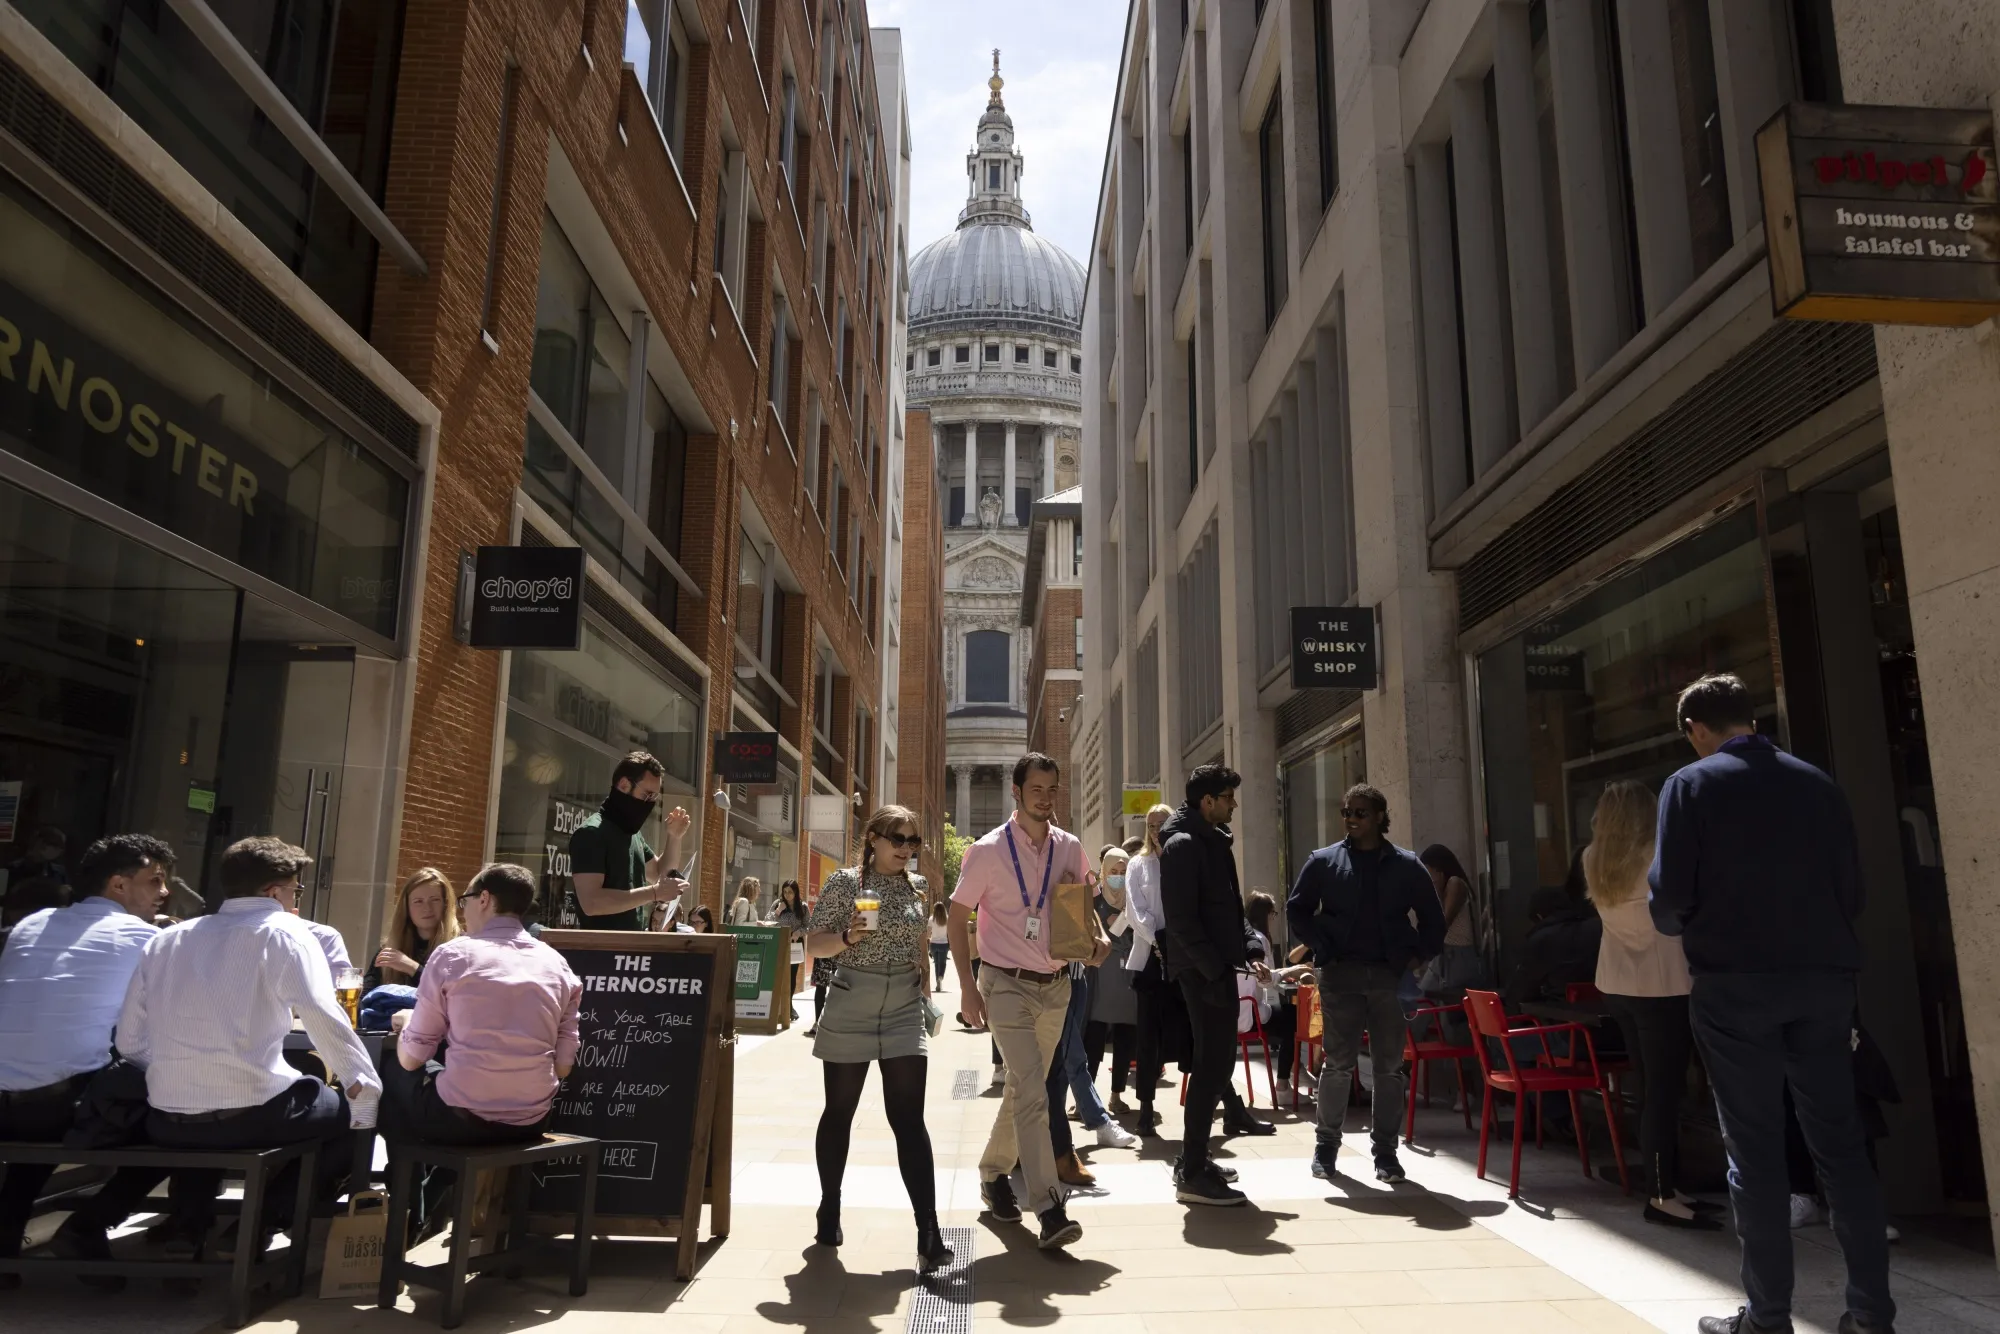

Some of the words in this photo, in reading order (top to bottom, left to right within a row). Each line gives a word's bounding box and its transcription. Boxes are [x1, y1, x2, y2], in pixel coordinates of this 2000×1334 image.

[1836, 208, 1949, 230] houmous
[1954, 213, 1974, 230] &
[1845, 236, 1924, 256] falafel
[1928, 240, 1971, 257] bar
[481, 576, 572, 602] chop'd
[1318, 621, 1348, 631] THE
[1303, 641, 1366, 652] WHISKY
[1314, 662, 1356, 672] SHOP
[553, 801, 591, 834] Brigh
[560, 909, 576, 925] New
[614, 955, 652, 972] THE
[576, 975, 703, 995] TERNOSTER
[614, 1009, 647, 1025] YOUR
[655, 1013, 693, 1026] TABLE
[592, 1029, 617, 1040] THE
[624, 1025, 673, 1044] EUROS
[580, 1082, 604, 1097] ARE
[611, 1081, 670, 1100] ALREADY
[607, 1103, 636, 1117] UP!!!
[603, 1148, 638, 1167] HERE
